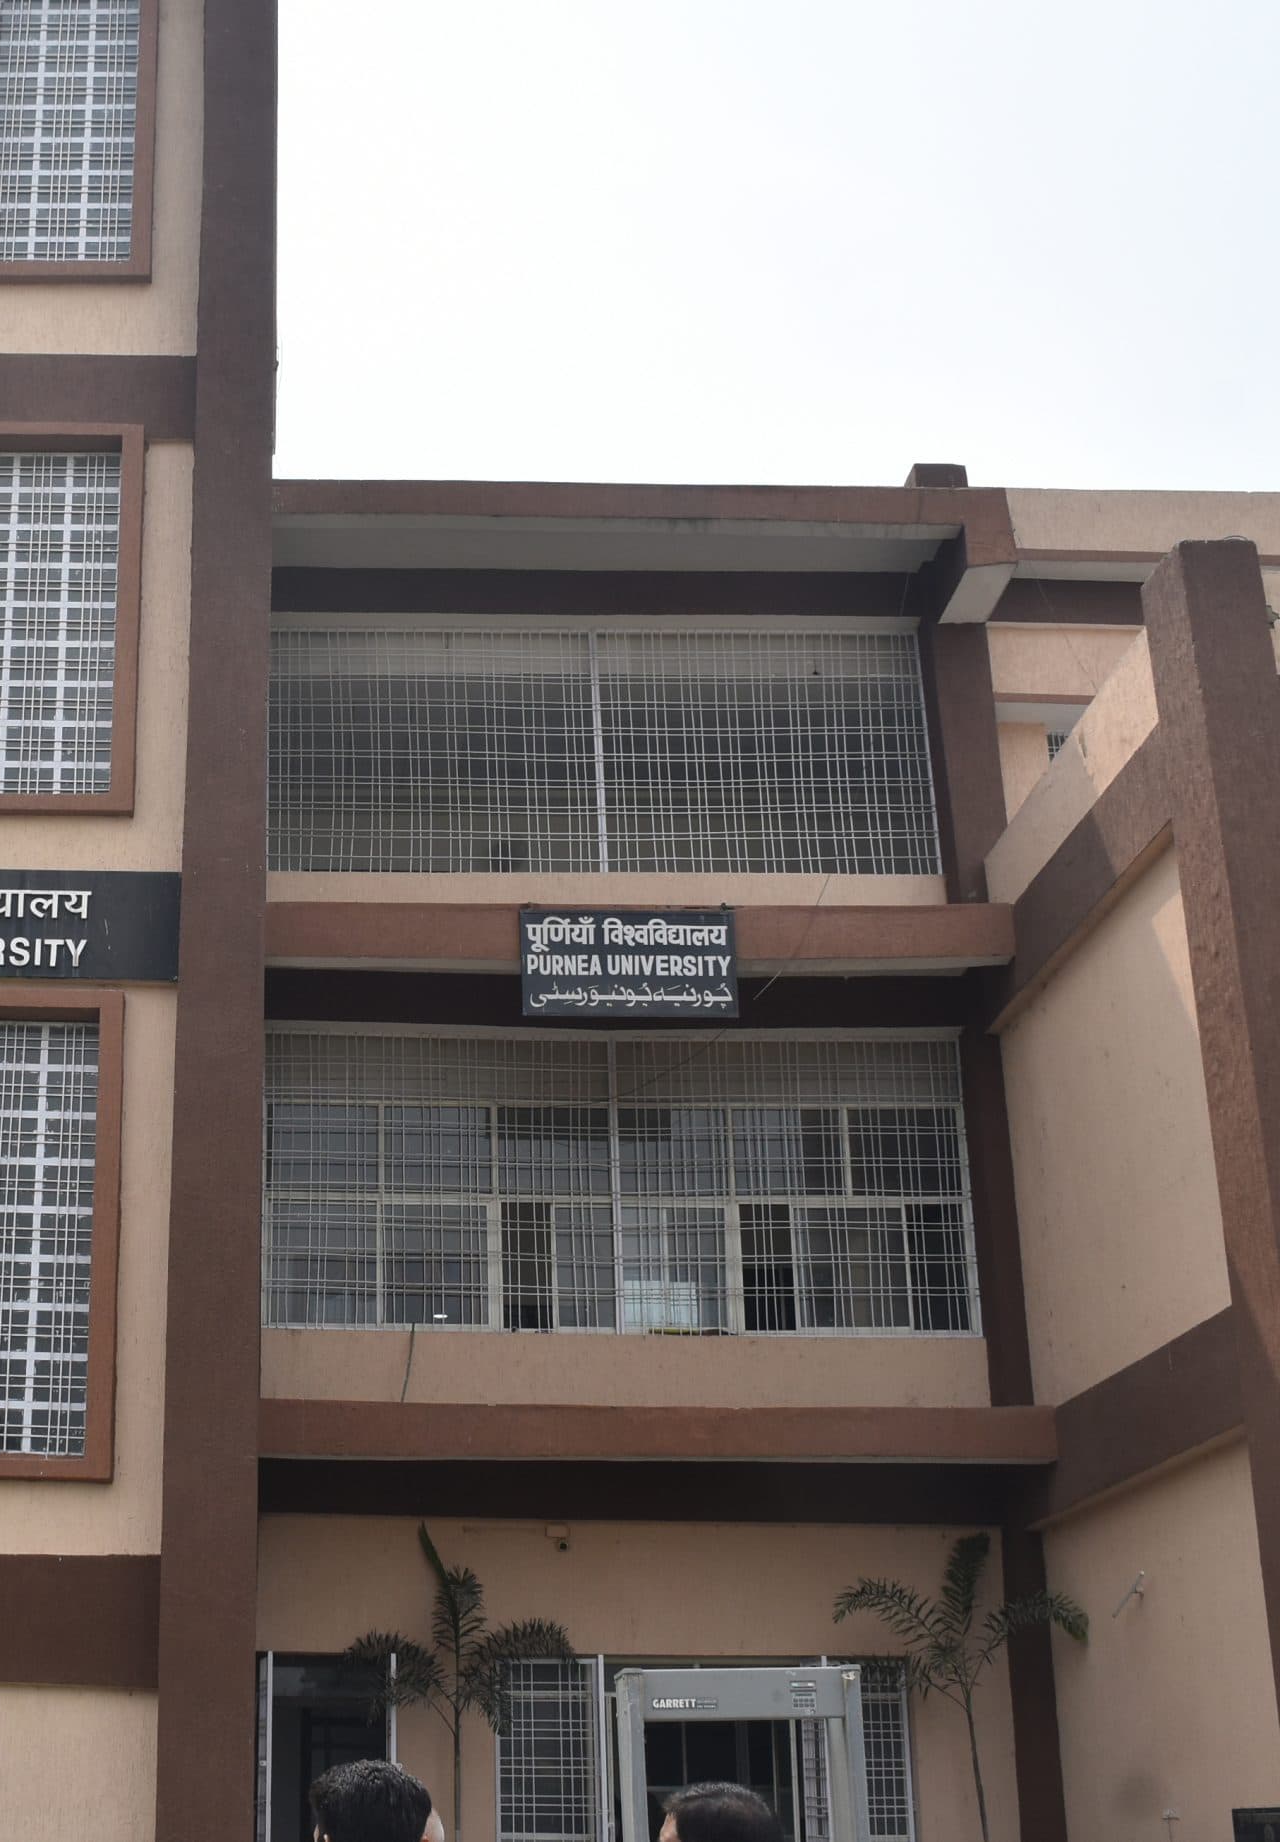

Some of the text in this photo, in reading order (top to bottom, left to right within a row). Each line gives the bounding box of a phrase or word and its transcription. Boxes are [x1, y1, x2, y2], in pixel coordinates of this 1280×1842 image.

[525, 916, 728, 952] पूर्णियाँ विश्वविद्यालय
[526, 954, 731, 976] PURNEA UNIVERSITY
[652, 1698, 696, 1708] GARRETT
